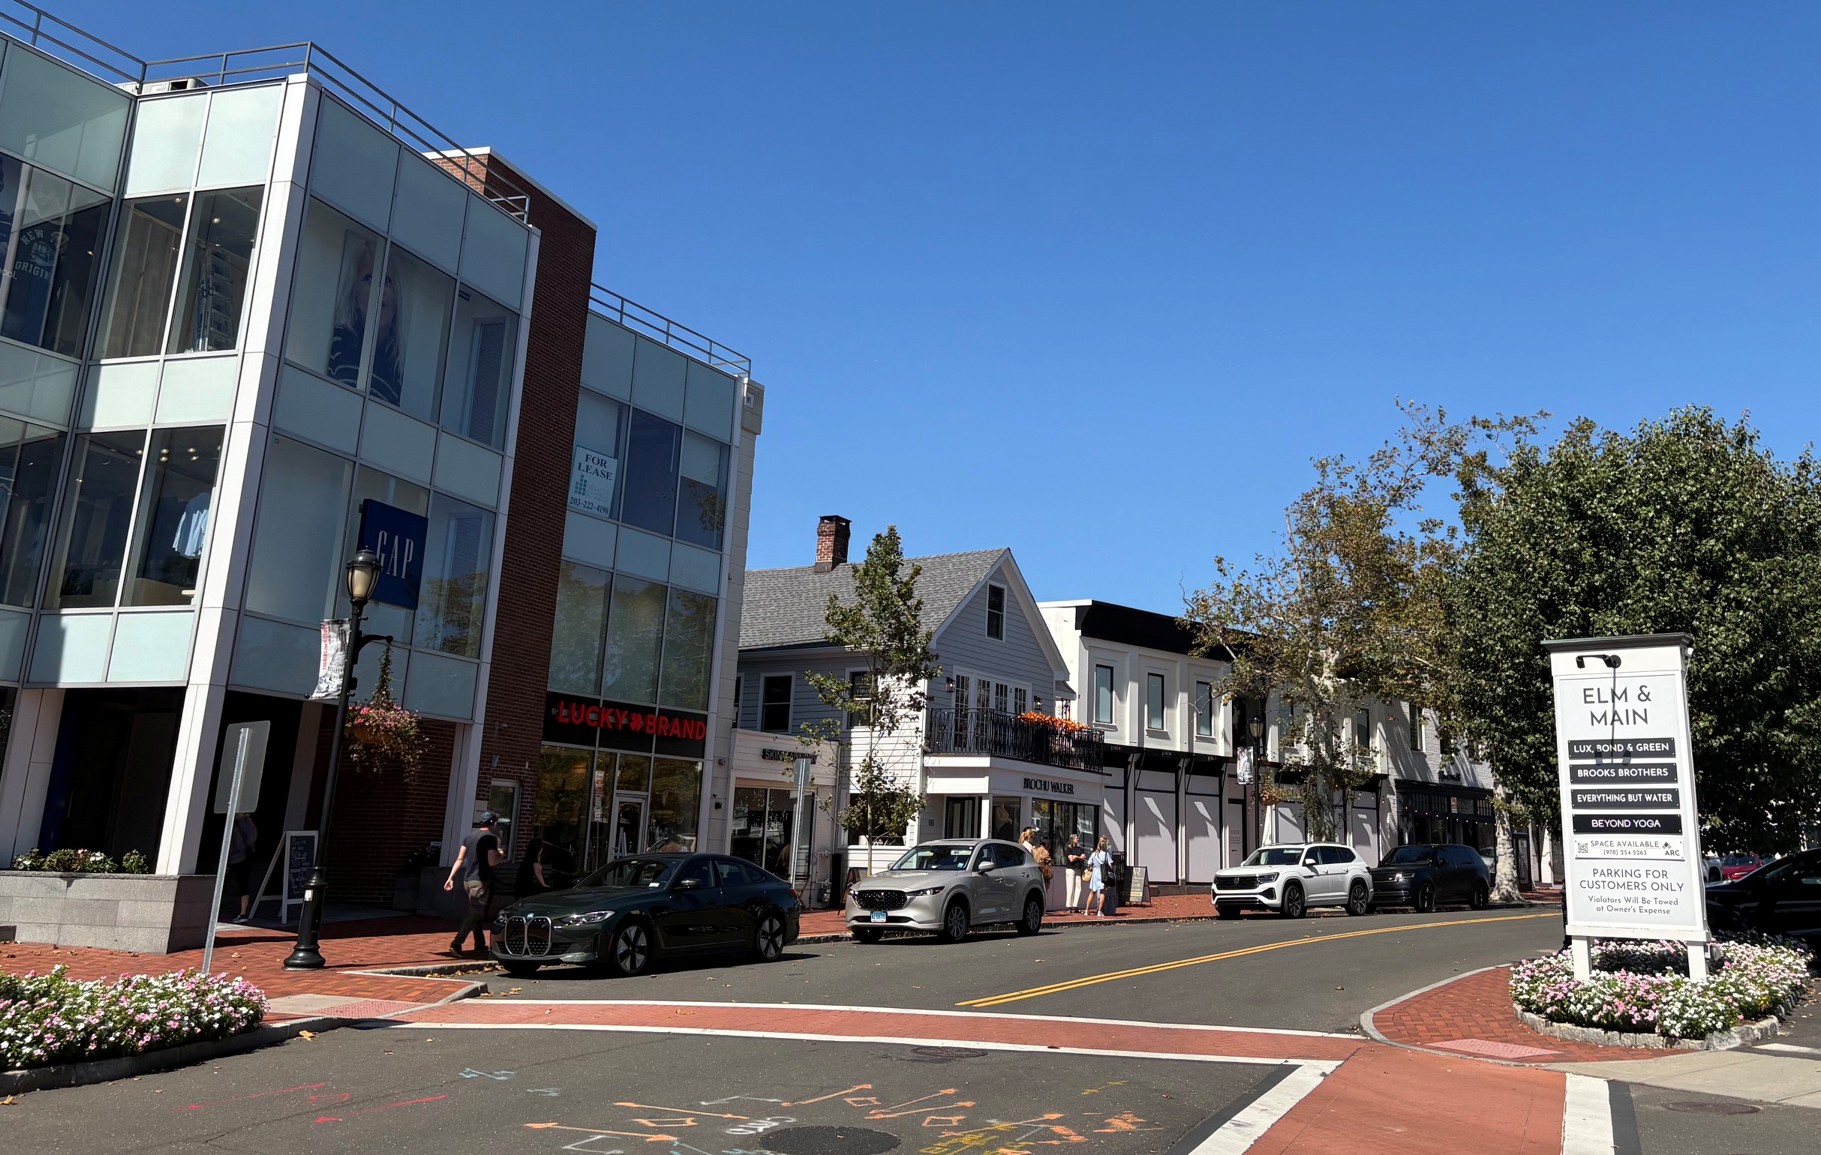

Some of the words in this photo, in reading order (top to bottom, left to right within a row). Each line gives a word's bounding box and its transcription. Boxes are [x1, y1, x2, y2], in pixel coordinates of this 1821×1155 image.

[20, 229, 44, 245] NEW
[0, 267, 17, 280] ool.
[585, 454, 607, 468] FOR
[578, 462, 612, 480] LEASE
[376, 530, 414, 579] GAP
[1583, 686, 1628, 704] ELM
[1637, 685, 1652, 702] &
[556, 701, 629, 730] LUCKY
[643, 713, 706, 740] BRAND
[1590, 708, 1648, 726] MAIN
[1573, 745, 1594, 754] LUX,
[1596, 744, 1624, 752] BOND
[1626, 743, 1633, 752] &
[1635, 743, 1669, 751] GREEN
[1577, 769, 1616, 777] BROOKS
[1618, 768, 1669, 777] BROTHERS
[1023, 778, 1050, 791] BROCHU
[1050, 781, 1074, 794] WALKER
[1577, 794, 1626, 802] EVERYTHING
[1627, 793, 1642, 802] BUT
[1644, 793, 1673, 802] WATER
[1591, 819, 1631, 828] BEYOND
[1632, 819, 1661, 828] YOGA
[1590, 840, 1614, 848] SPACE
[1616, 840, 1660, 848] AVAILABLE
[1592, 868, 1641, 879] PARKING
[1645, 869, 1669, 880] FOR
[1579, 880, 1647, 891] CUSTOMERS
[1650, 881, 1684, 892] ONLY
[1588, 895, 1621, 904] Violators
[1623, 896, 1639, 905] Will
[1641, 897, 1652, 905] Be
[1654, 897, 1679, 906] Towed
[1606, 905, 1636, 913] Owner's
[1638, 906, 1671, 915] Expense
